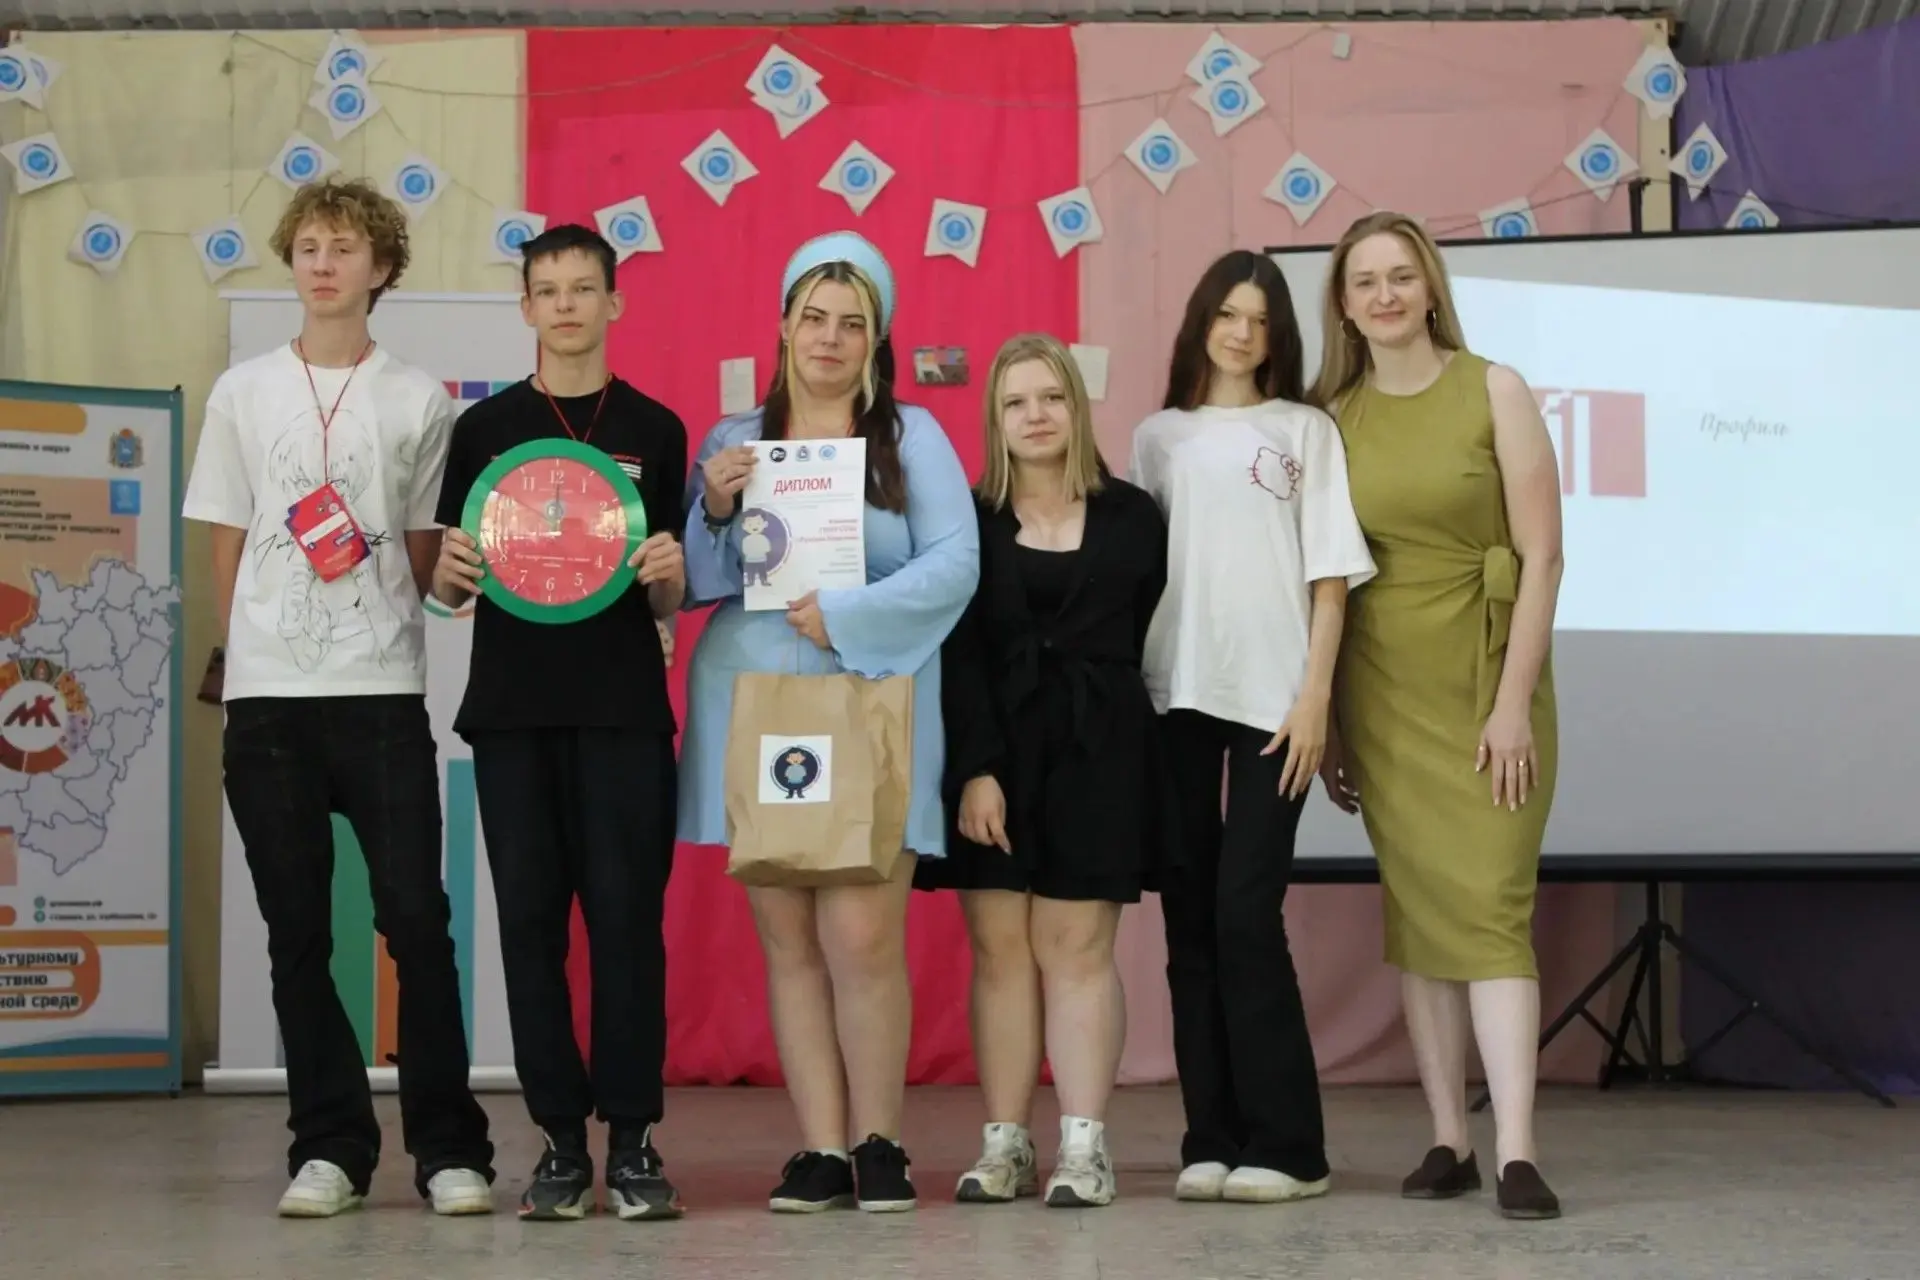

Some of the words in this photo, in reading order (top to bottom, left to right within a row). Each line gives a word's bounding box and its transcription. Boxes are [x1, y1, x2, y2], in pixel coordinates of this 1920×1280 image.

[523, 476, 535, 491] 11
[549, 470, 565, 485] 12
[580, 478, 588, 494] 1
[773, 476, 832, 496] ДИПЛОМ
[595, 555, 604, 568] 4
[520, 570, 528, 584] 7
[546, 577, 555, 591] 6
[574, 573, 584, 587] 5
[32, 995, 80, 1010] среде
